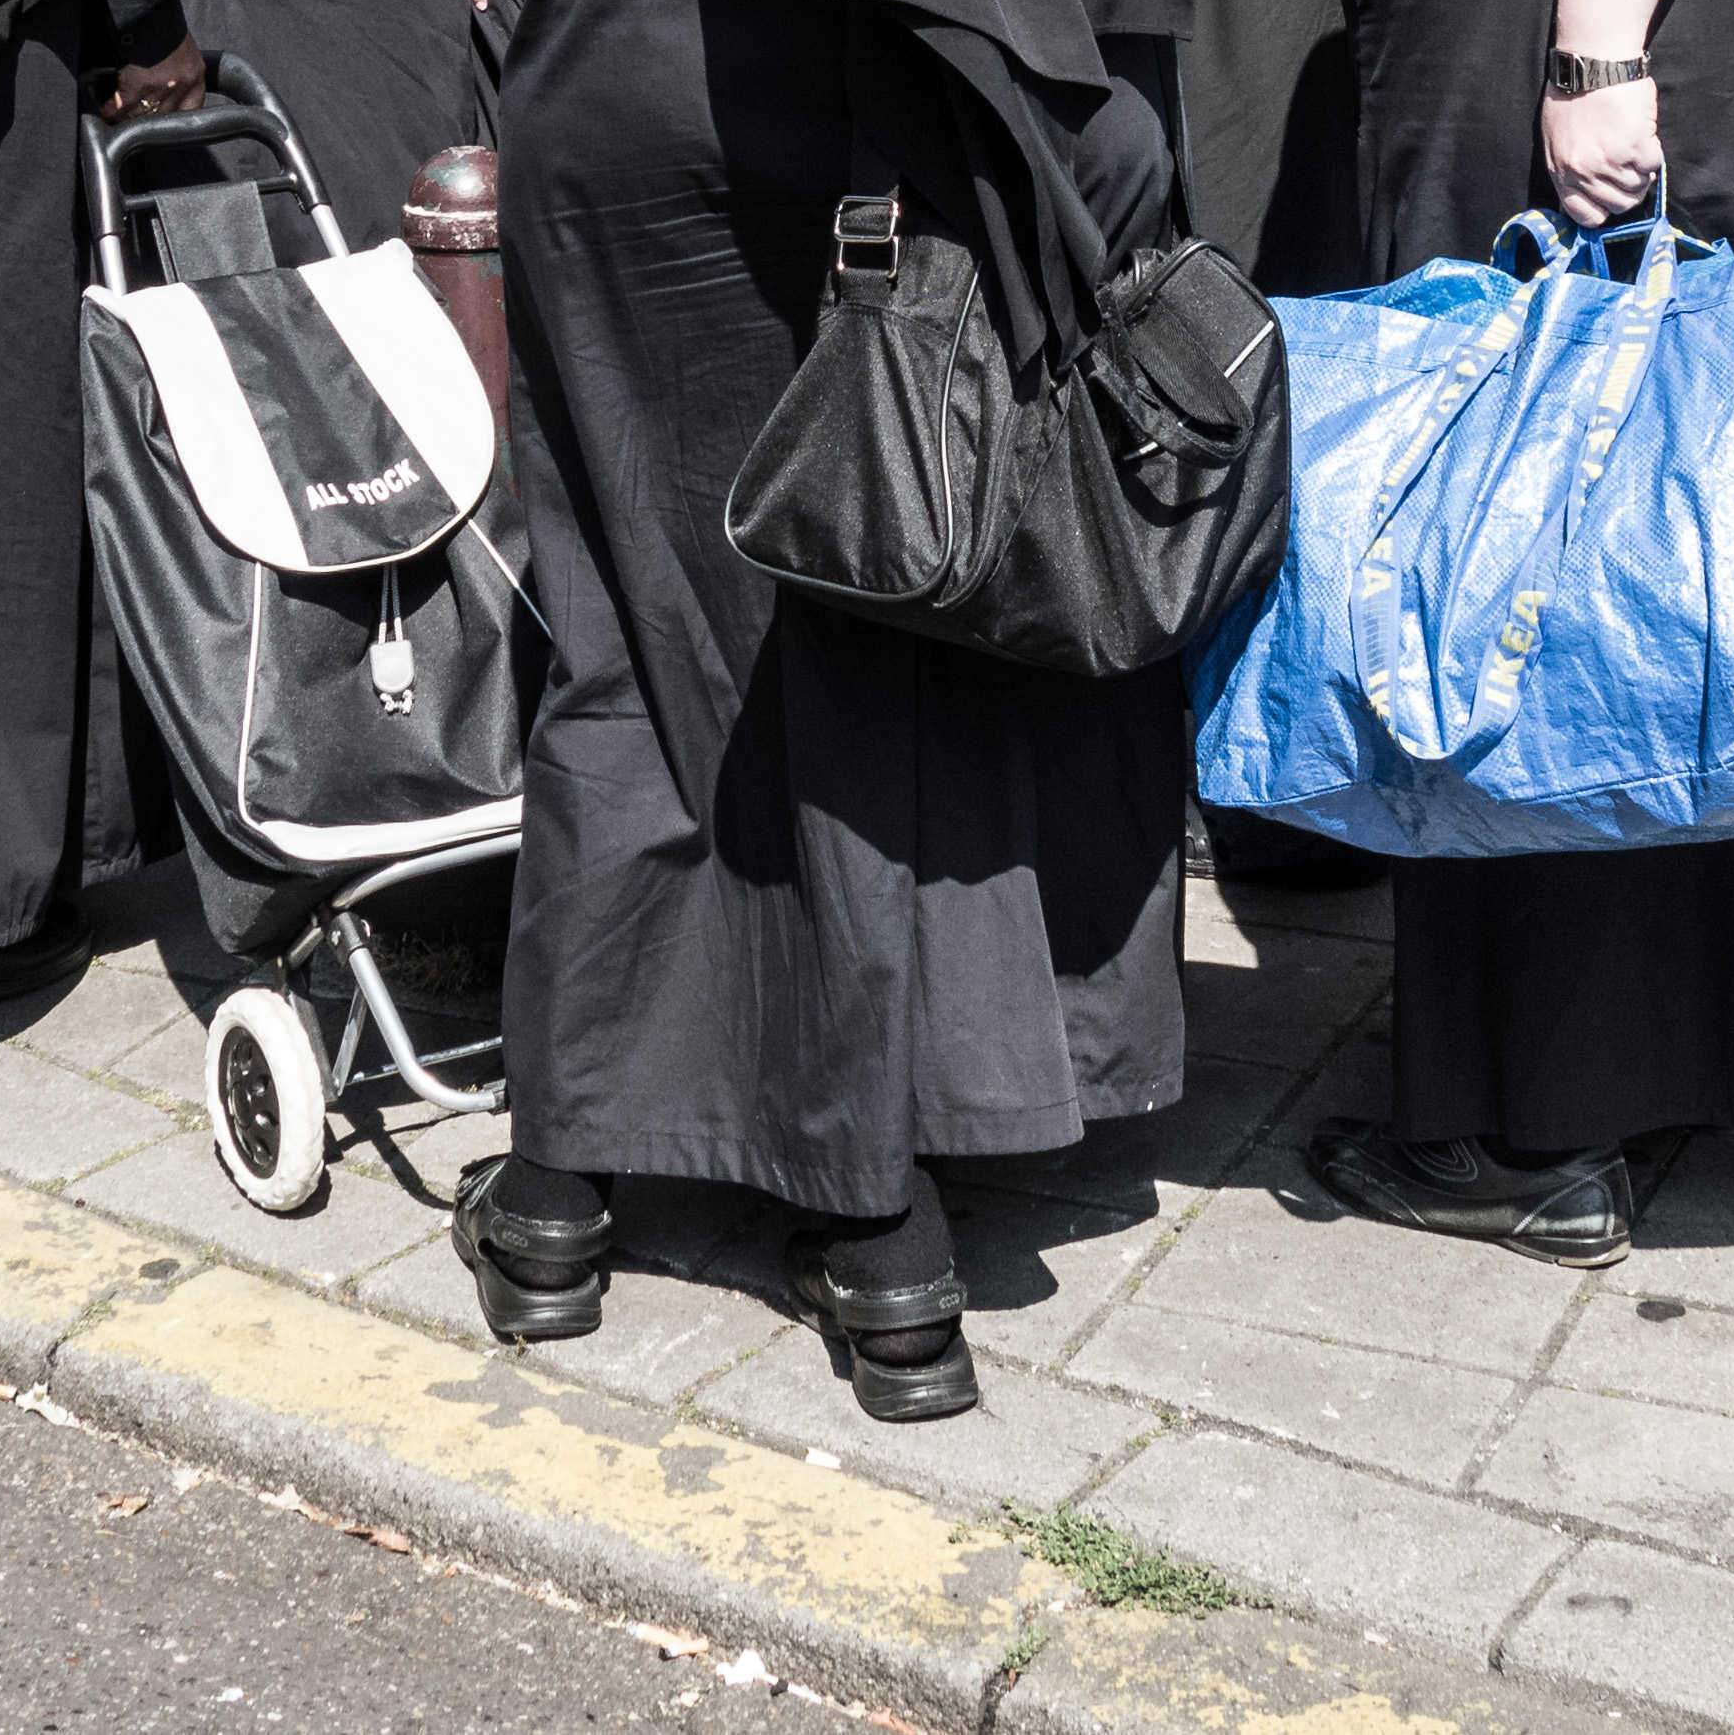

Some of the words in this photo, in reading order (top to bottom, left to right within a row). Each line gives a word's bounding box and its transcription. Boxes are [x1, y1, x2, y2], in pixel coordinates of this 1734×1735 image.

[306, 482, 349, 511] ALL
[347, 458, 421, 505] STOCK
[1485, 590, 1549, 709] IKEA
